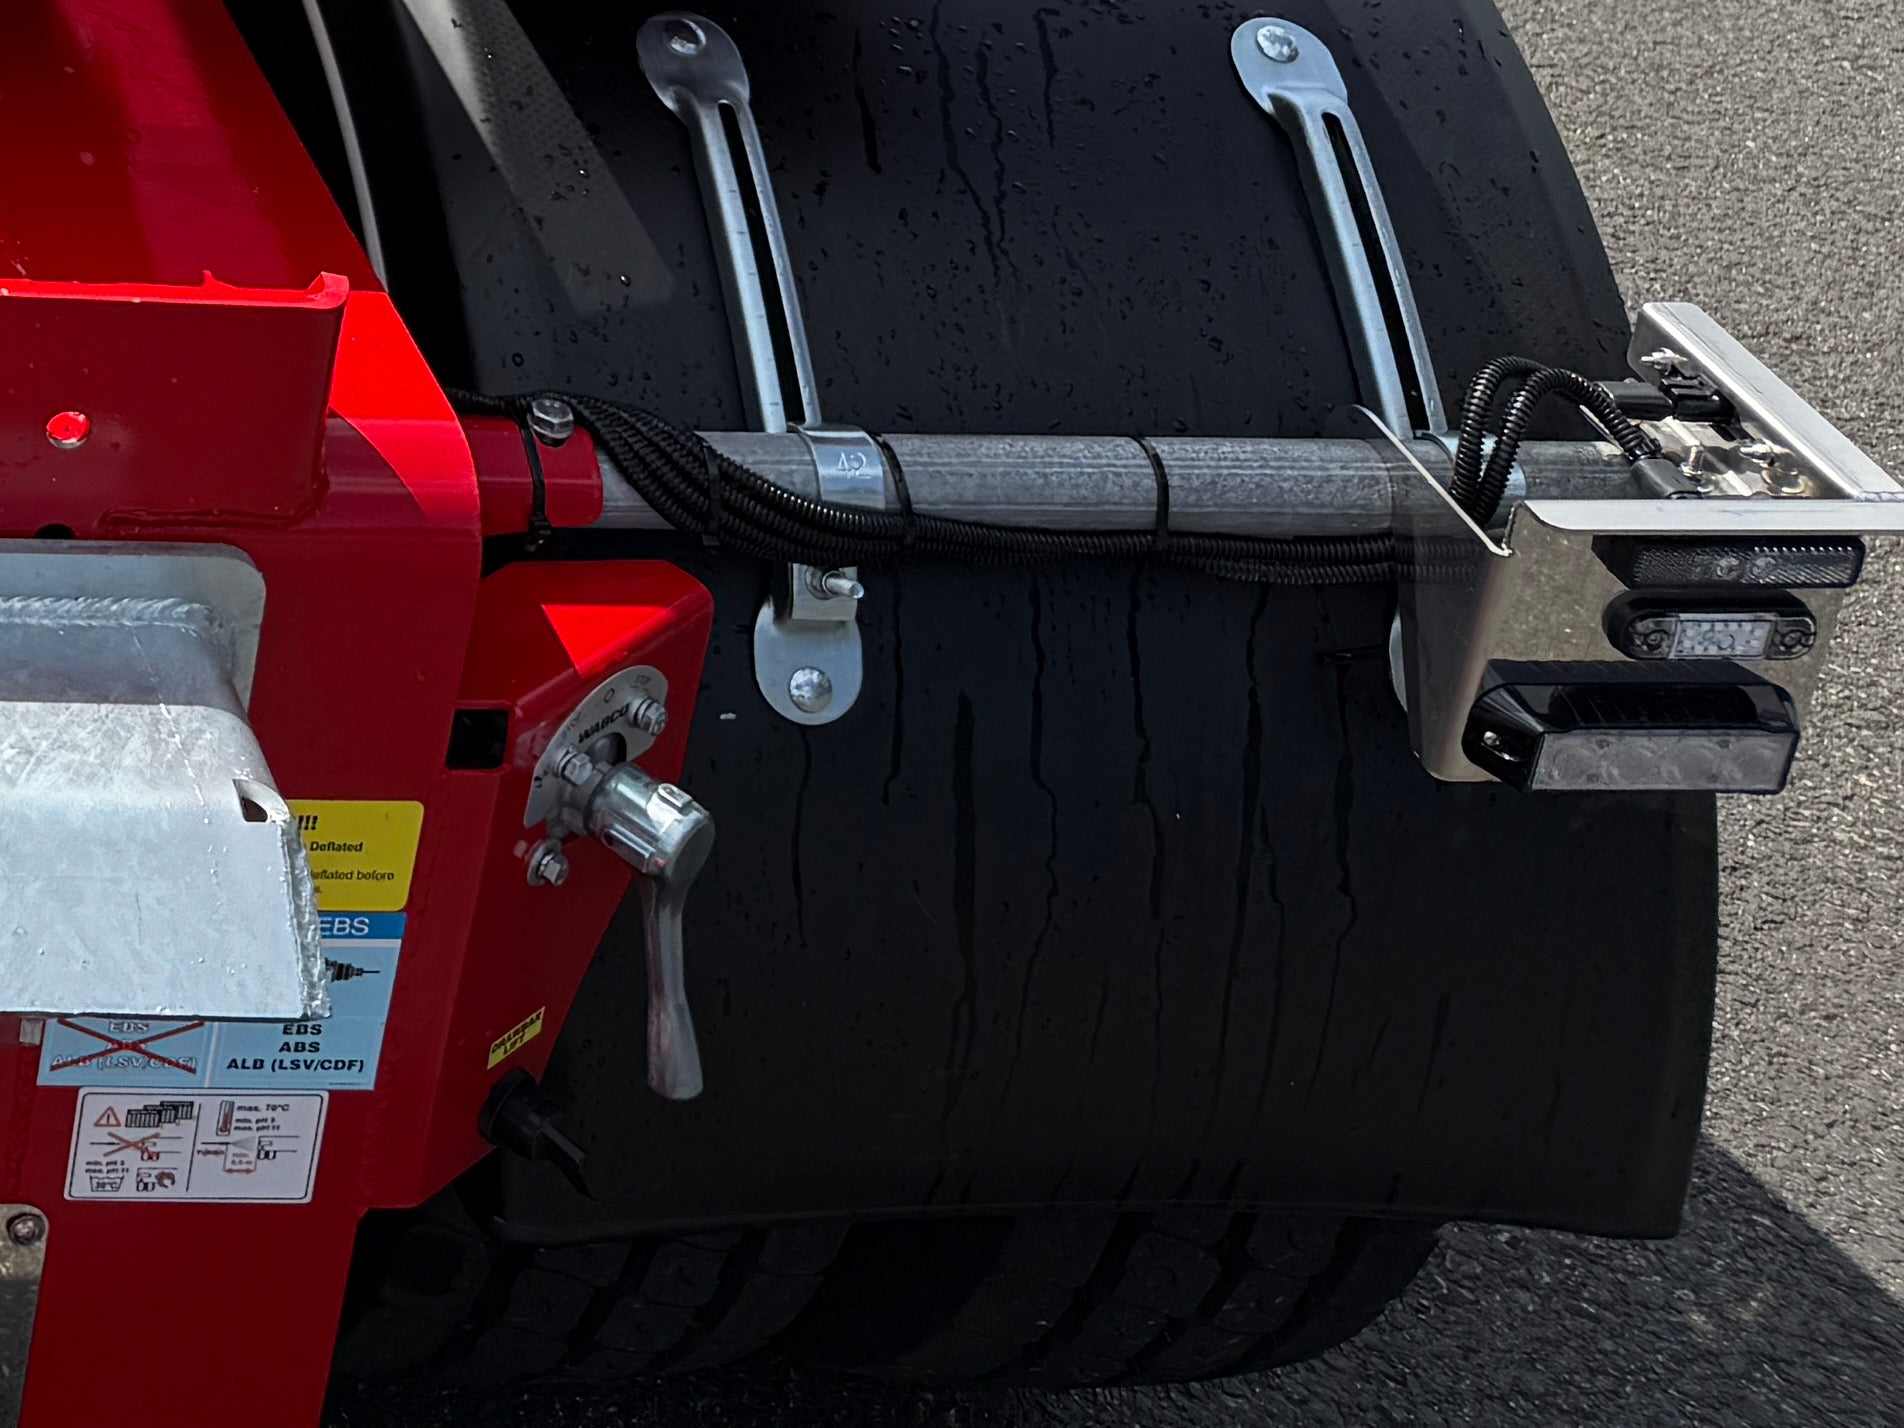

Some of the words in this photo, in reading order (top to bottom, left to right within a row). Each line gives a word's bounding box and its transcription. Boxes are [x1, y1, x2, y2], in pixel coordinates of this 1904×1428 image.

[836, 452, 871, 479] 42
[578, 703, 630, 744] WABCO
[309, 841, 363, 852] Deflated
[356, 870, 395, 881] before
[319, 916, 370, 936] EBS
[282, 1023, 323, 1035] EBS
[278, 1041, 320, 1053] ABS
[227, 1058, 264, 1070] ALB
[271, 1059, 364, 1073] (LSV/CDF)
